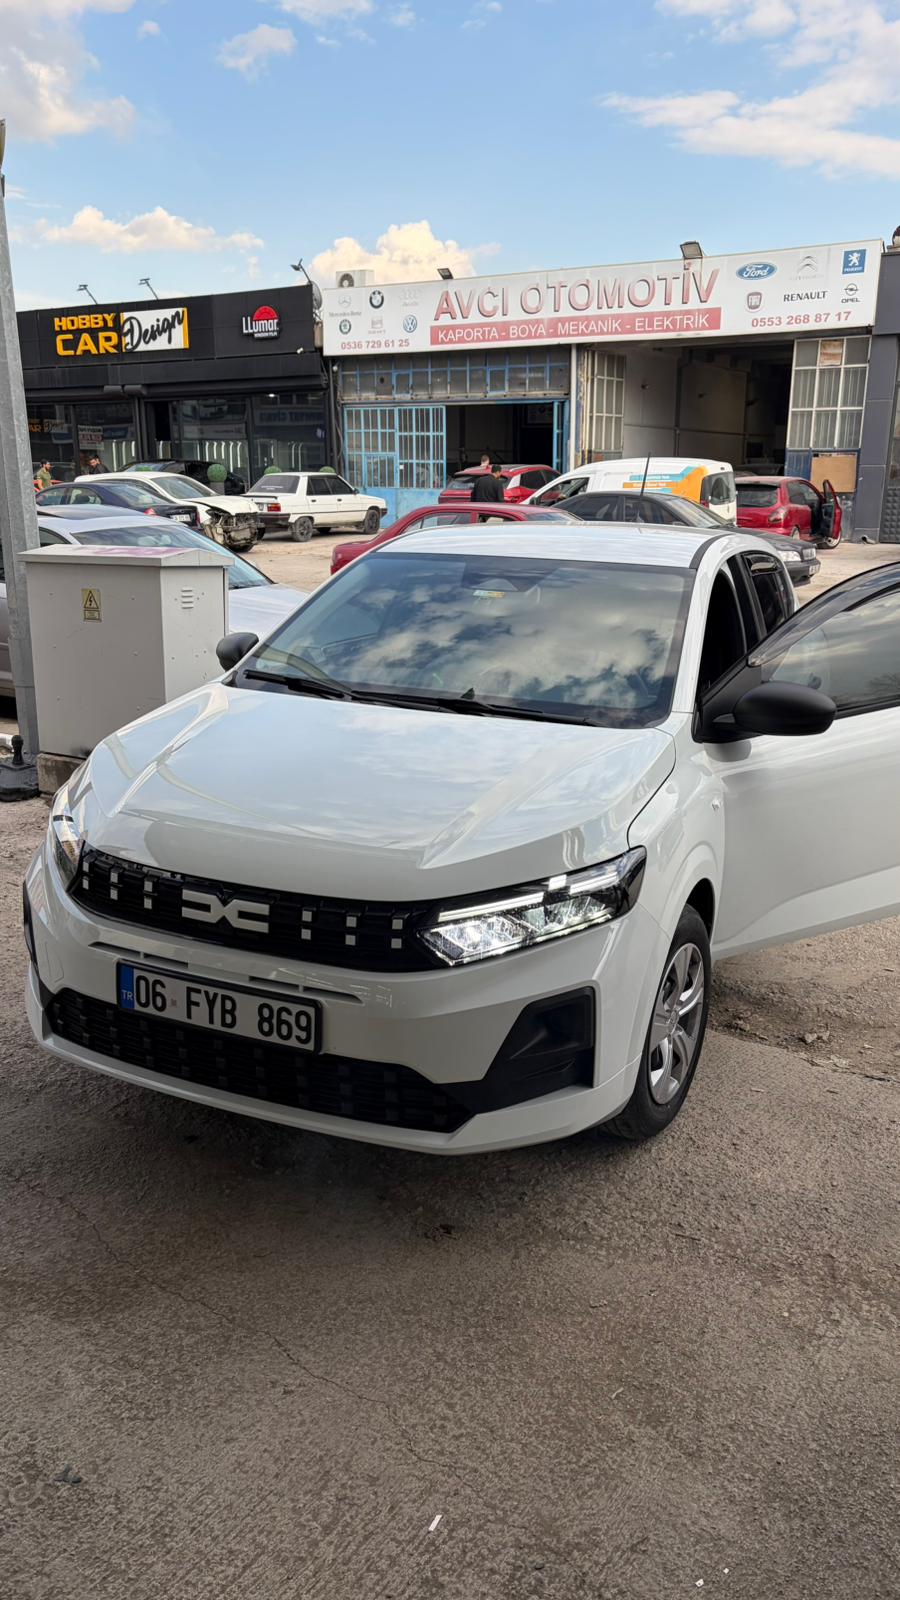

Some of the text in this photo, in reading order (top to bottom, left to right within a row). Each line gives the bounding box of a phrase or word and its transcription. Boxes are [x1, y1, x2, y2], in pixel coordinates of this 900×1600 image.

[743, 264, 769, 278] Ford
[434, 262, 720, 321] AVCI OTOMOTİV
[783, 290, 829, 302] RENAULT
[54, 312, 116, 331] HOBBY
[438, 327, 499, 343] KAPORTA
[510, 323, 546, 338] BOYA
[558, 317, 622, 335] MEKANİK
[635, 312, 710, 331] ELEKTRİK
[751, 311, 852, 328] 0553 268 87 17
[121, 310, 184, 353] Design
[56, 332, 119, 356] CAR
[341, 338, 410, 350] 0536 729 61 25
[121, 989, 133, 1001] TR
[135, 975, 312, 1044] 06 FYB 869
